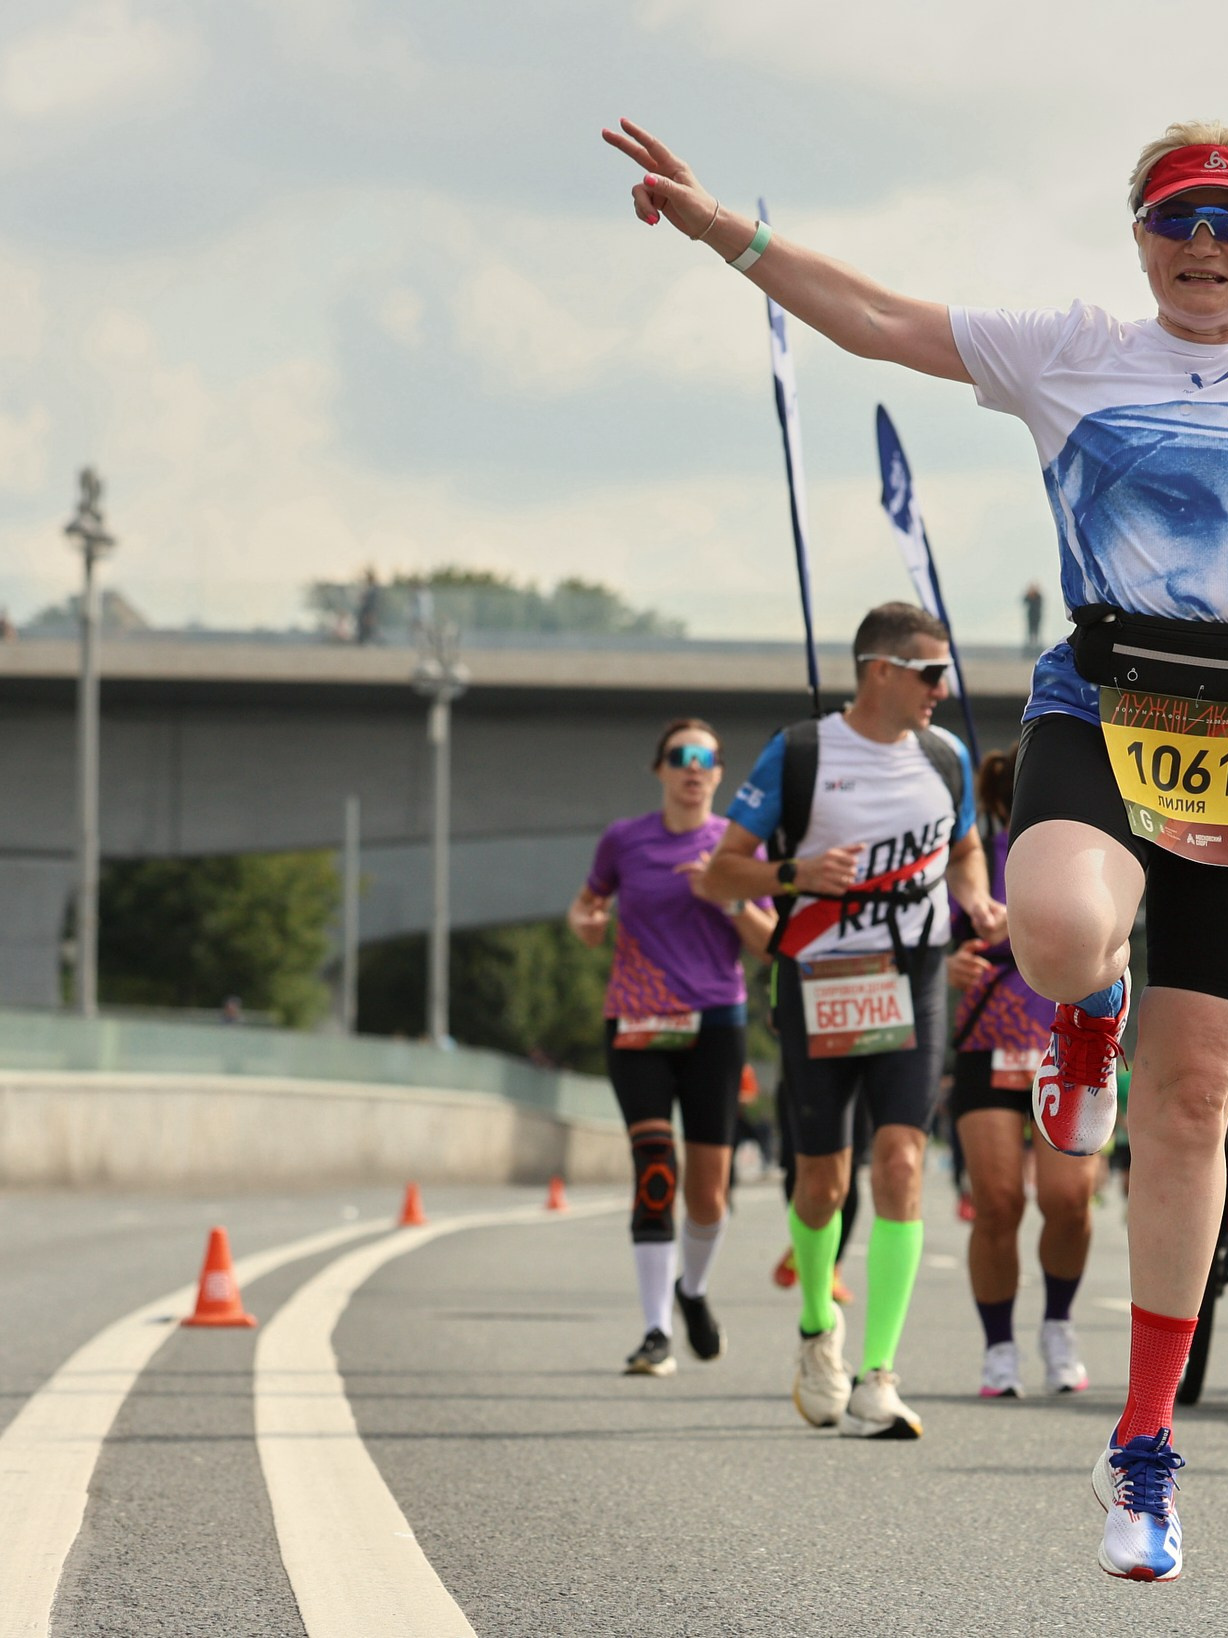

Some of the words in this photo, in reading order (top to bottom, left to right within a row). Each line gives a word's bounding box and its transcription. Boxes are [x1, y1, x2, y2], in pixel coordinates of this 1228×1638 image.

[1158, 795, 1206, 814] ЛИЛИЯ
[1139, 809, 1154, 833] G
[816, 994, 903, 1029] БЕГУНА
